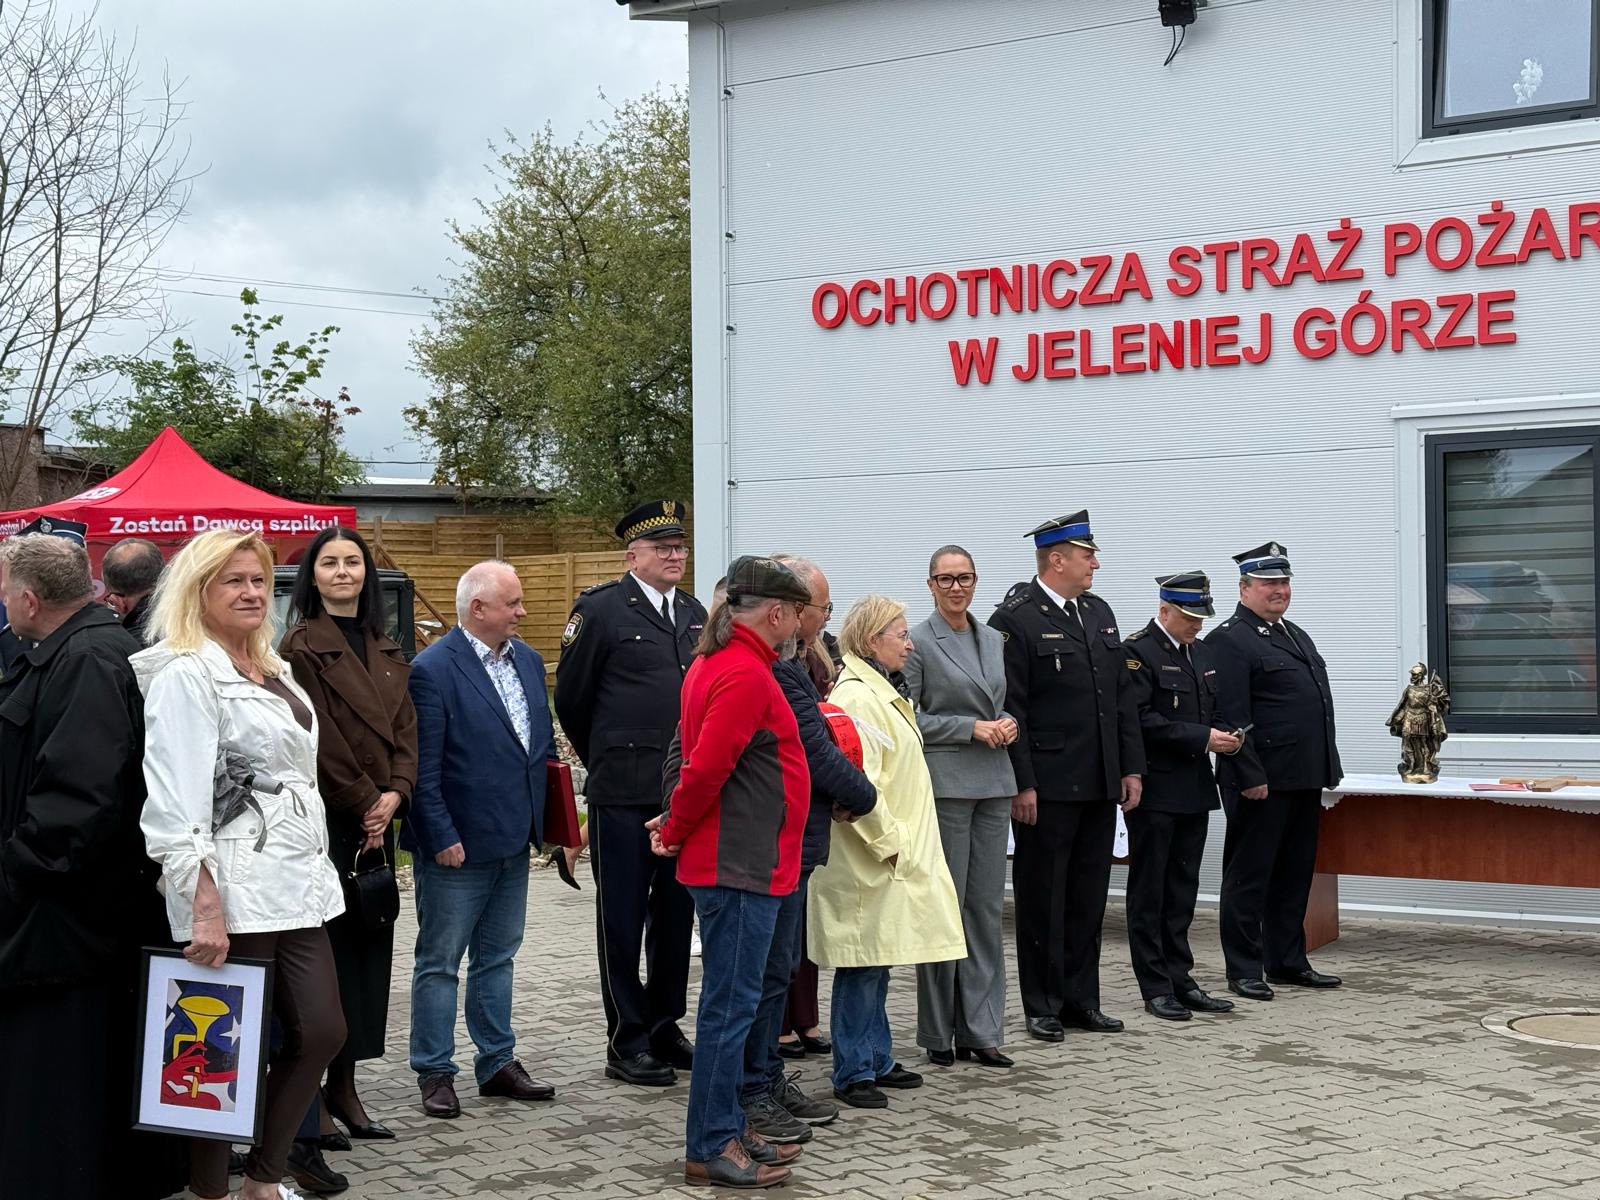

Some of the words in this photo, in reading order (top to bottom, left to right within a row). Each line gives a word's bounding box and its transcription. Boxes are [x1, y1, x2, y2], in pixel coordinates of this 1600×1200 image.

[812, 252, 1153, 329] OCHOTNICZA
[1166, 217, 1364, 297] STRAŻ
[1384, 200, 1600, 277] POŻAR
[948, 336, 999, 386] W
[1012, 312, 1272, 382] JELENIEJ
[1293, 289, 1517, 360] GÓRZE
[109, 515, 187, 533] Zostań
